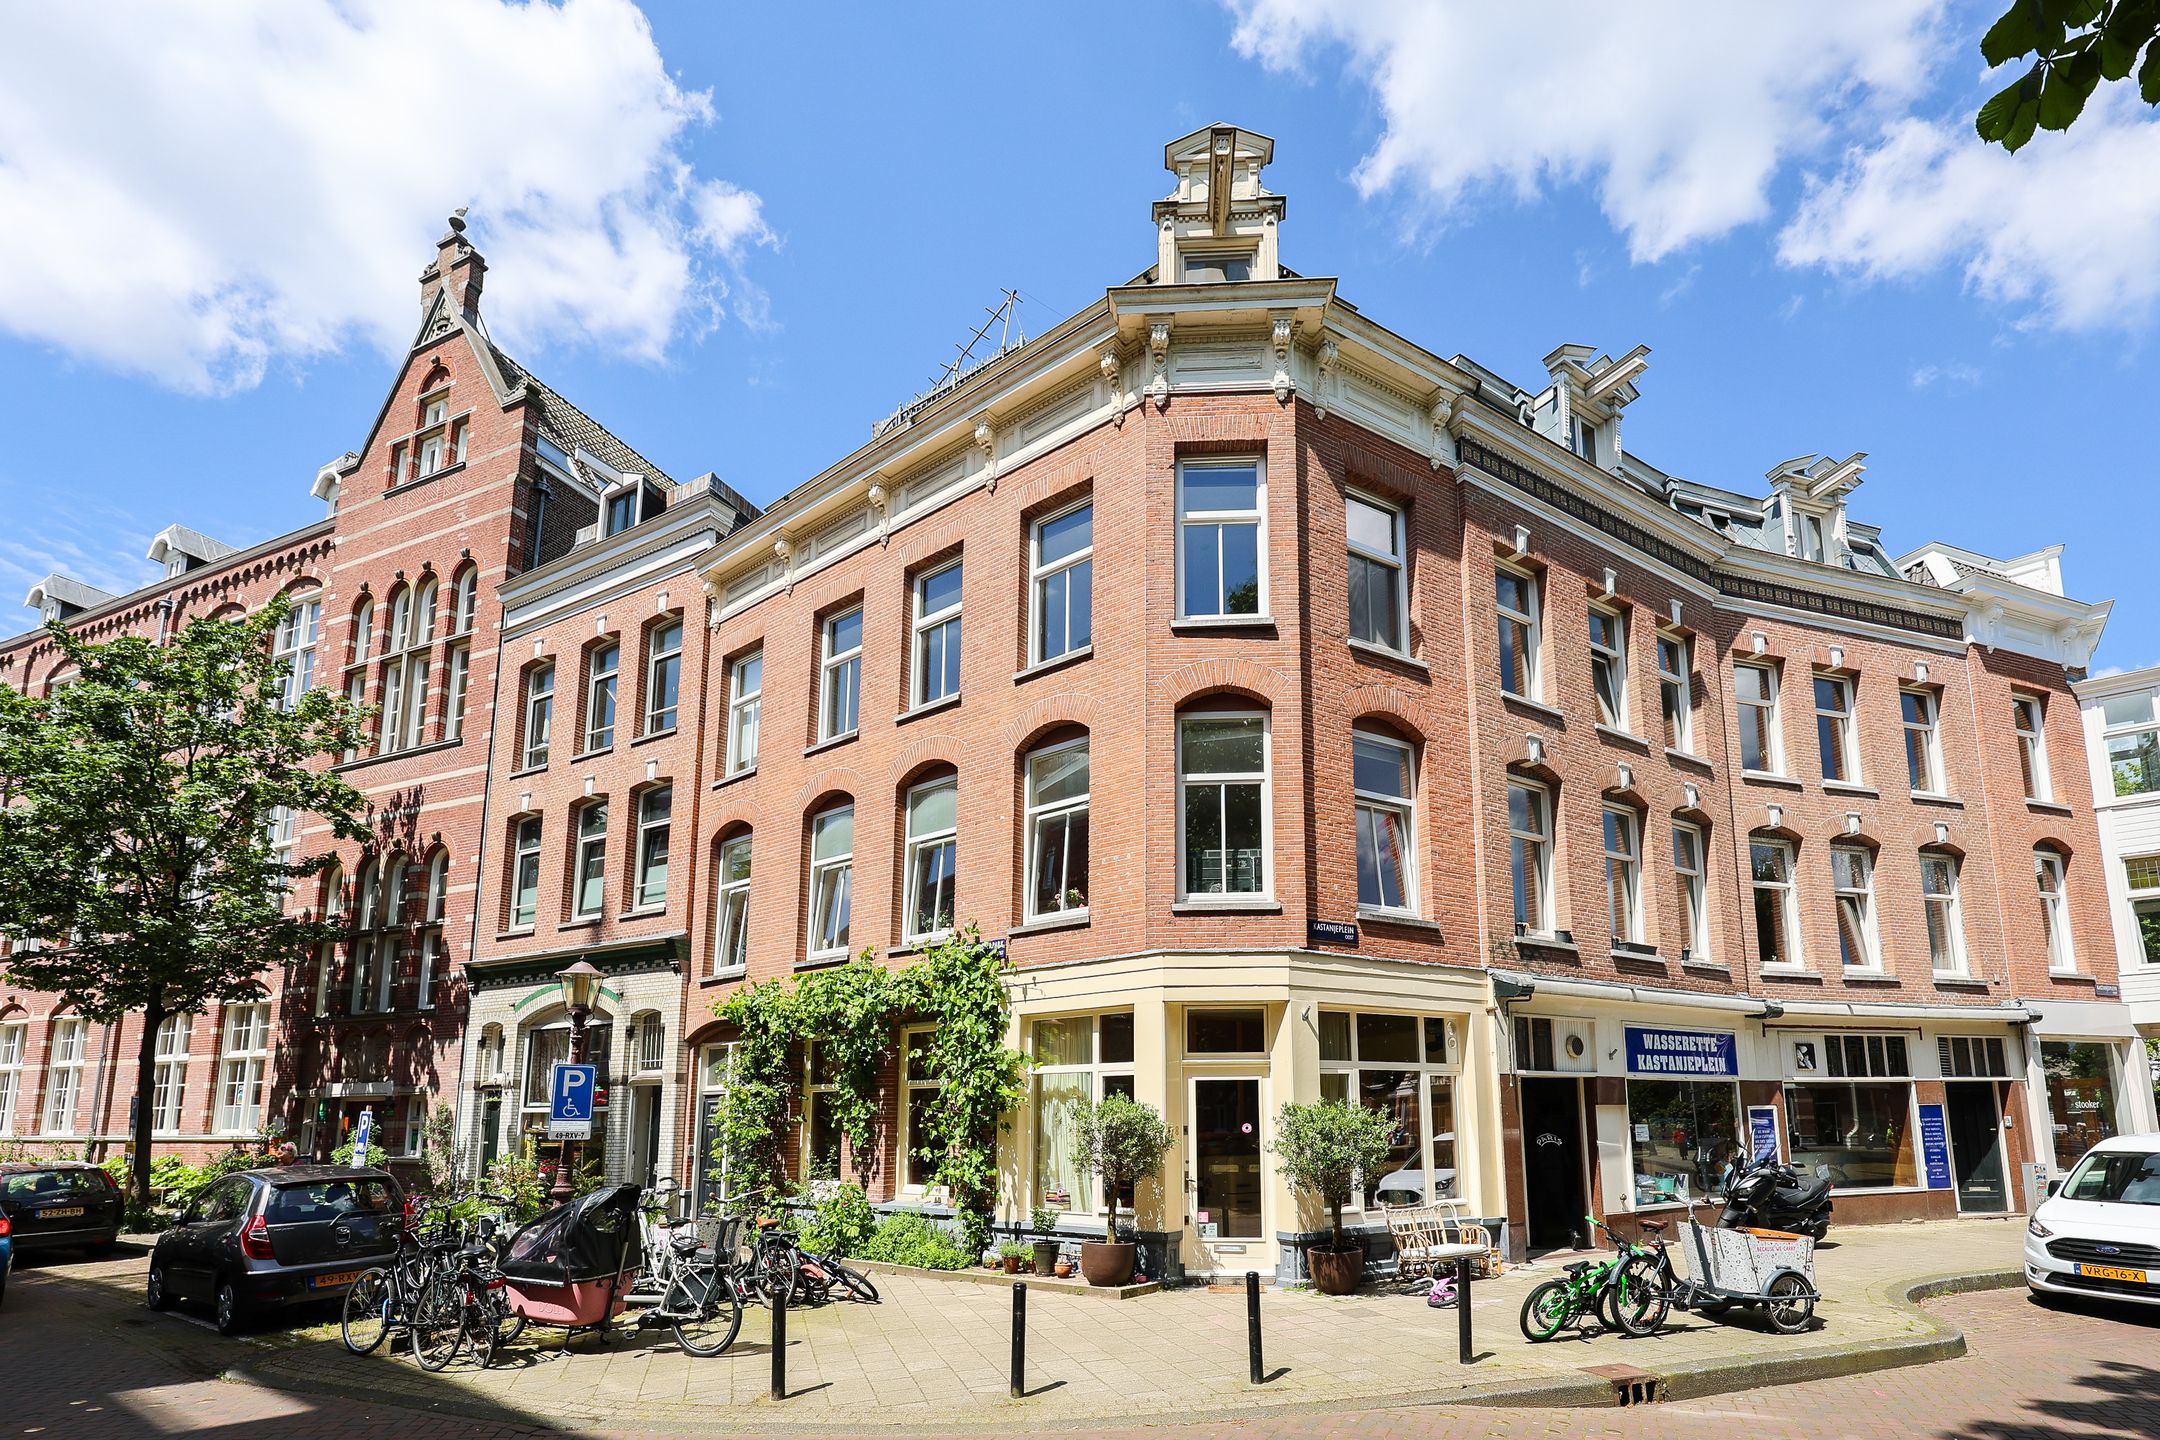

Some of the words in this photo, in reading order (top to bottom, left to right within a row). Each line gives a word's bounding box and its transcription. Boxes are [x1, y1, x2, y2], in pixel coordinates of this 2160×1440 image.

[1313, 923, 1355, 934] KASTANJEPLEIN
[1642, 1033, 1718, 1053] WASSERETTE
[1637, 1054, 1727, 1072] KASTANJEPLEIN
[562, 1069, 586, 1097] P
[2074, 1100, 2100, 1109] stooker
[359, 1115, 369, 1138] P
[320, 1271, 366, 1285] 49-RXV
[2085, 1266, 2140, 1280] VRG-16-X
